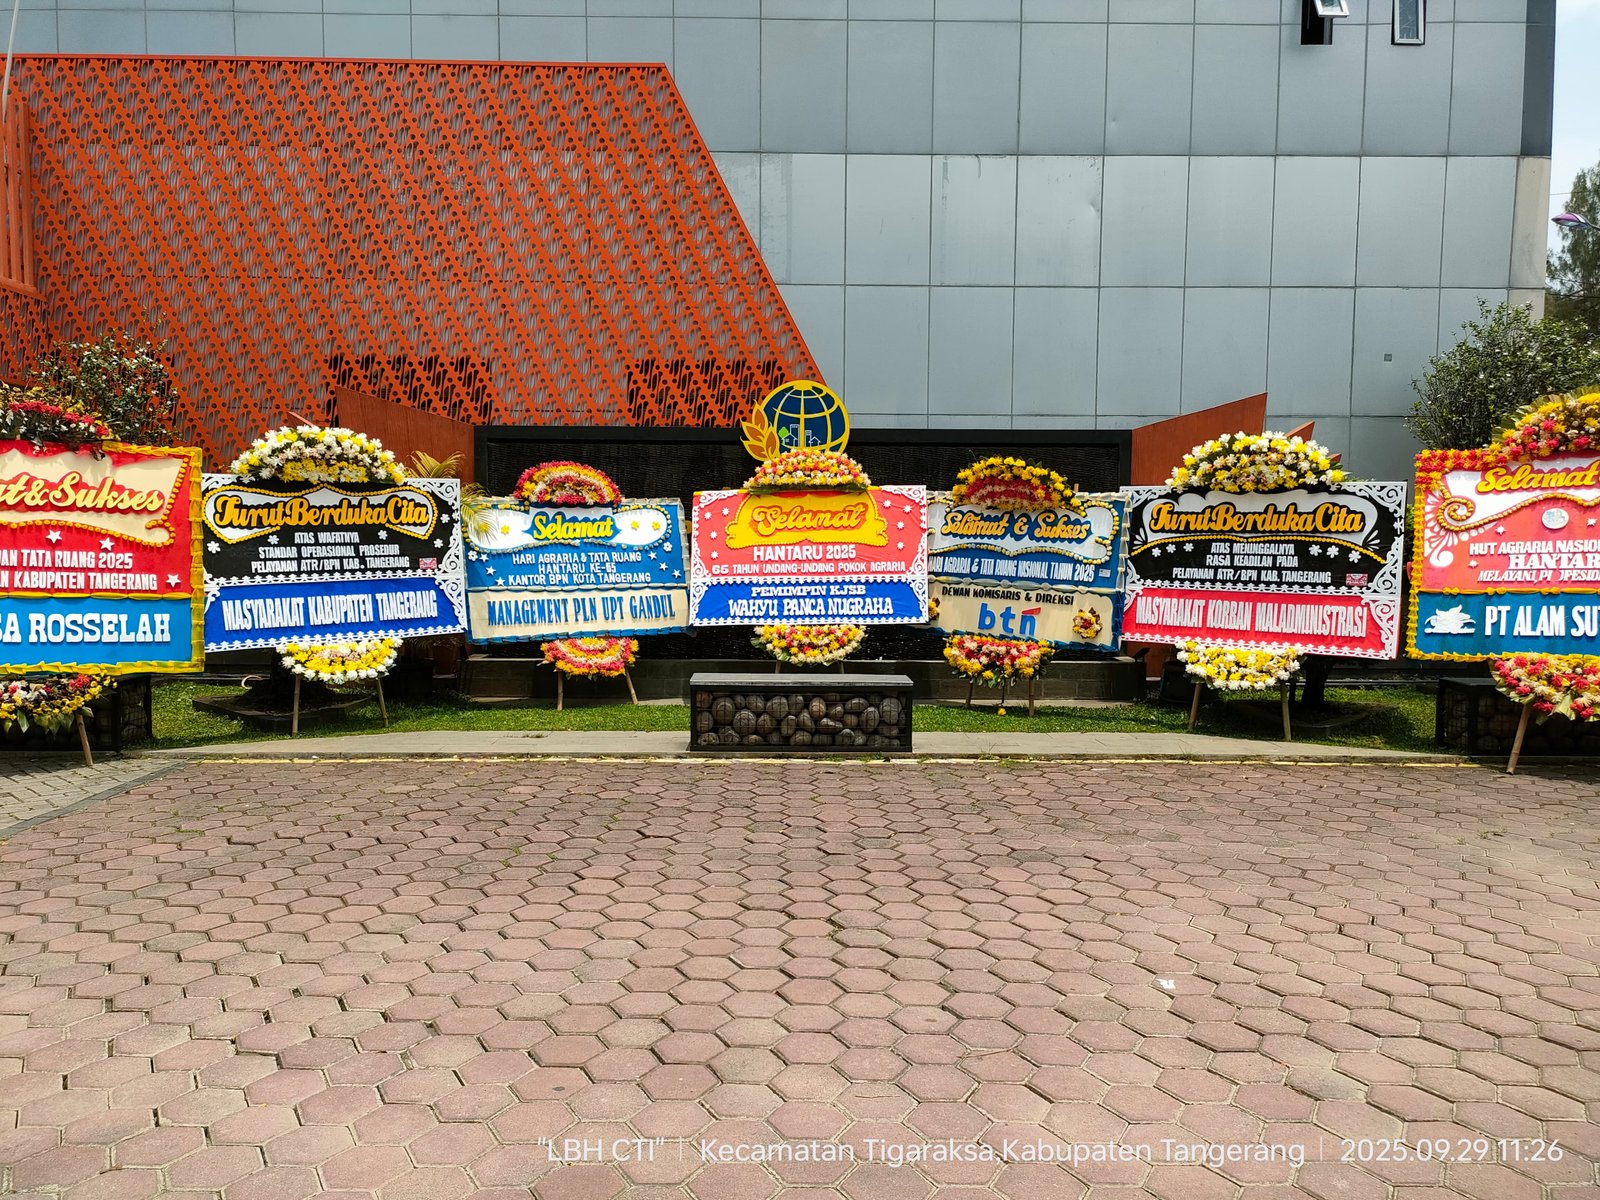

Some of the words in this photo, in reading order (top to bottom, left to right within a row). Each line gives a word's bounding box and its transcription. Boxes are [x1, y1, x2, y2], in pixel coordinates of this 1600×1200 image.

[1477, 460, 1600, 492] Selamat
[49, 473, 164, 511] Sukses
[533, 515, 614, 540] Selamat
[753, 504, 865, 535] Selamat
[941, 512, 1011, 536] Selamat
[1014, 516, 1028, 535] &
[1034, 512, 1090, 539] Sukses
[294, 533, 314, 544] ATAS
[318, 532, 360, 543] WAFATNYA
[1469, 542, 1497, 555] HUT
[1498, 540, 1553, 554] AGRARIA
[1555, 539, 1600, 553] NASIO
[258, 547, 297, 559] STANDAR
[301, 545, 355, 558] OPERASIONAL
[359, 544, 400, 556] PROSEDUR
[512, 553, 535, 564] HARI
[538, 553, 580, 563] AGRARIA
[580, 552, 587, 563] &
[588, 552, 610, 562] TATA
[612, 551, 641, 562] RUANG
[753, 546, 823, 561] HANTARU
[825, 545, 856, 559] 2025
[1210, 542, 1230, 554] ATAS
[1232, 542, 1295, 555] MENINGGALNYA
[0, 549, 17, 567] AN
[21, 549, 52, 567] TATA
[55, 551, 95, 568] RUANG
[98, 553, 133, 569] 2025
[251, 560, 298, 573] PELAYANAN
[301, 559, 341, 571] ATR/BPN
[366, 556, 410, 569] TANGERANG
[538, 563, 585, 574] HANTARU
[712, 564, 729, 575] 65
[732, 564, 759, 574] TAHUN
[763, 562, 834, 573] UNDANG-UNDANG
[838, 561, 866, 572] POKOK
[870, 561, 906, 572] AGRARIA
[1206, 555, 1231, 566] RASA
[1233, 555, 1272, 567] KEADILAN
[1276, 556, 1298, 567] PADA
[508, 574, 547, 585] KANTOR
[549, 574, 569, 584] BPN
[573, 573, 596, 584] KOTA
[597, 572, 651, 583] TANGERANG
[943, 557, 970, 573] AGRARIA
[971, 558, 979, 573] &
[980, 558, 994, 575] TATA
[994, 559, 1017, 576] RUANG
[1017, 560, 1048, 579] NASIONAL
[1050, 562, 1073, 580] TAHUN
[1074, 563, 1095, 582] 2025
[1172, 568, 1214, 580] PELAYANAN
[1216, 568, 1257, 581] ATR/BPN
[1260, 569, 1280, 582] KAB.
[1281, 570, 1332, 584] TANGERANG
[14, 571, 85, 589] KABUPATEN
[88, 573, 158, 591] TANGERANG
[751, 585, 826, 597] PEMIMPIN
[829, 585, 866, 596] KJSB
[942, 586, 970, 597] DEWAN
[973, 589, 1021, 600] KOMISARIS
[1025, 592, 1032, 602] &
[1035, 593, 1074, 605] DIREKSI
[222, 597, 304, 631] MASYARAKAT
[307, 594, 373, 625] KABUPATEN
[376, 590, 438, 620] TANGERANG
[487, 598, 568, 626] MANAGEMENT
[573, 597, 597, 622] PLN
[601, 596, 624, 620] UPT
[629, 594, 675, 619] GANDUL
[728, 599, 778, 617] WAHYU
[783, 598, 825, 616] PANCA
[828, 597, 893, 615] NUGRAHA
[1136, 596, 1205, 628] MASYARAKAT
[1206, 600, 1252, 631] KORBAN
[1255, 602, 1367, 638] MALADMINISTRASI
[29, 612, 171, 643] ROSSELAH
[978, 602, 1039, 636] btn
[1485, 606, 1511, 636] PT
[1513, 605, 1566, 636] ALAM
[1570, 605, 1600, 637] SU
